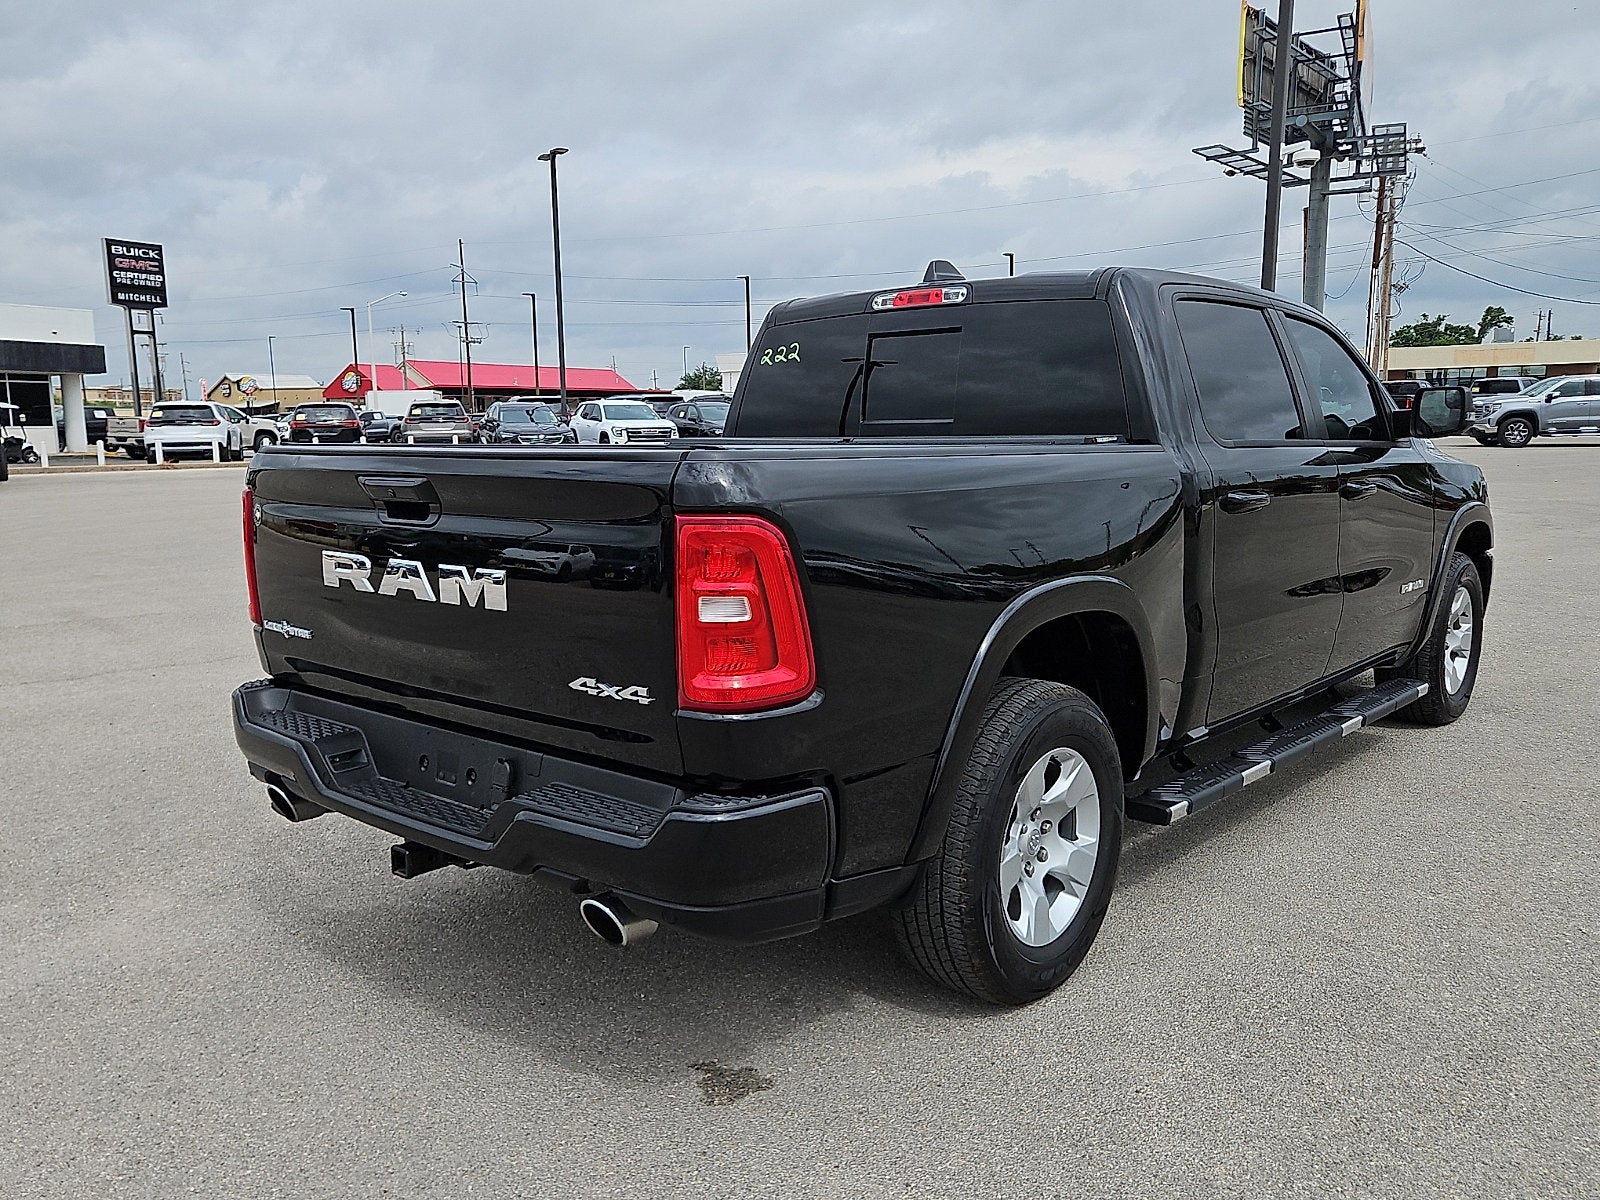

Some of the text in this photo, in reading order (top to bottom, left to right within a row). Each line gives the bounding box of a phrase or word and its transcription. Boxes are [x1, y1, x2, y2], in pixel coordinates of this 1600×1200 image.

[111, 245, 161, 259] BUICK
[115, 258, 159, 271] GMC
[113, 271, 163, 281] CERTIFIED
[117, 292, 163, 303] MITCHELL
[760, 342, 801, 366] 222
[321, 549, 508, 612] RAM
[567, 676, 656, 705] 4x4
